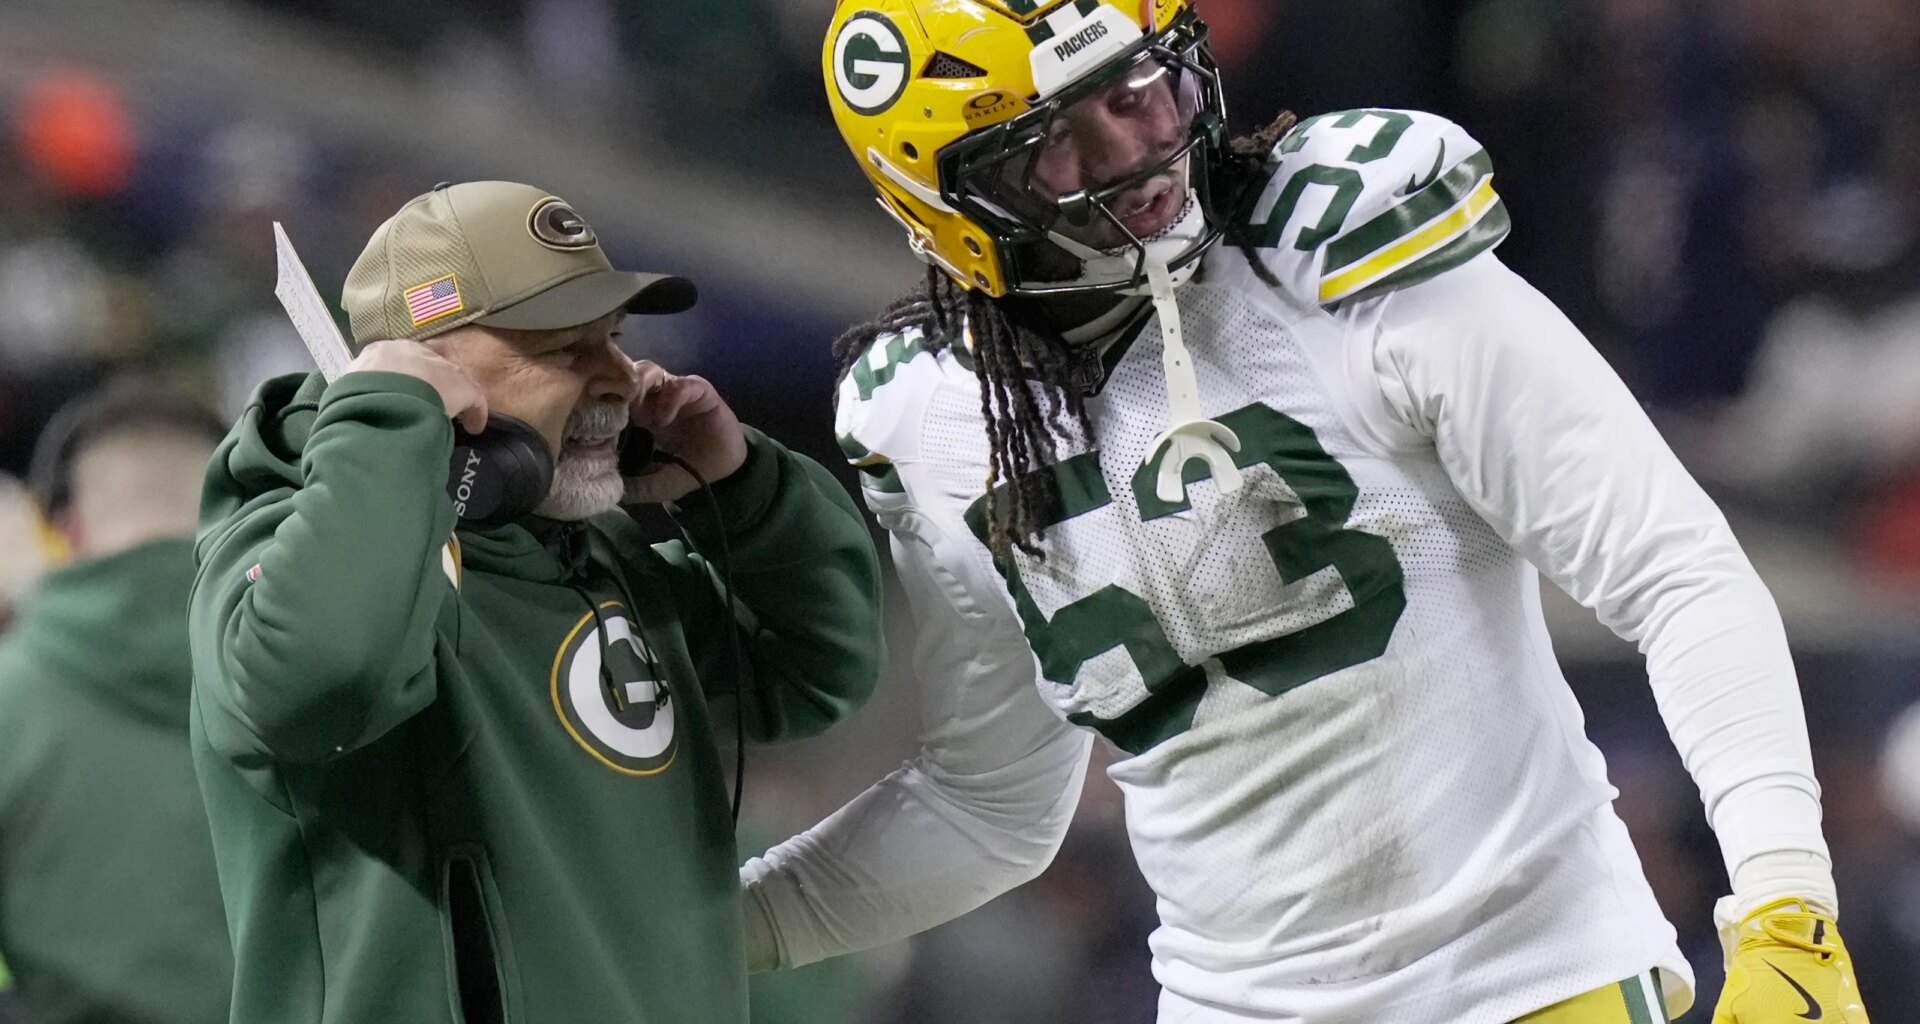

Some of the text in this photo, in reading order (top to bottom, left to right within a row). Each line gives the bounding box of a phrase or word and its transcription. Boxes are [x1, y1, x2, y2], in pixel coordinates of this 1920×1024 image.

[834, 17, 905, 108] G
[1054, 20, 1108, 62] PACKERS
[965, 101, 1015, 120] OAKLEY
[1223, 109, 1411, 251] 53
[533, 201, 594, 244] G
[453, 448, 481, 516] SONY
[964, 402, 1406, 755] 53
[569, 616, 674, 758] G
